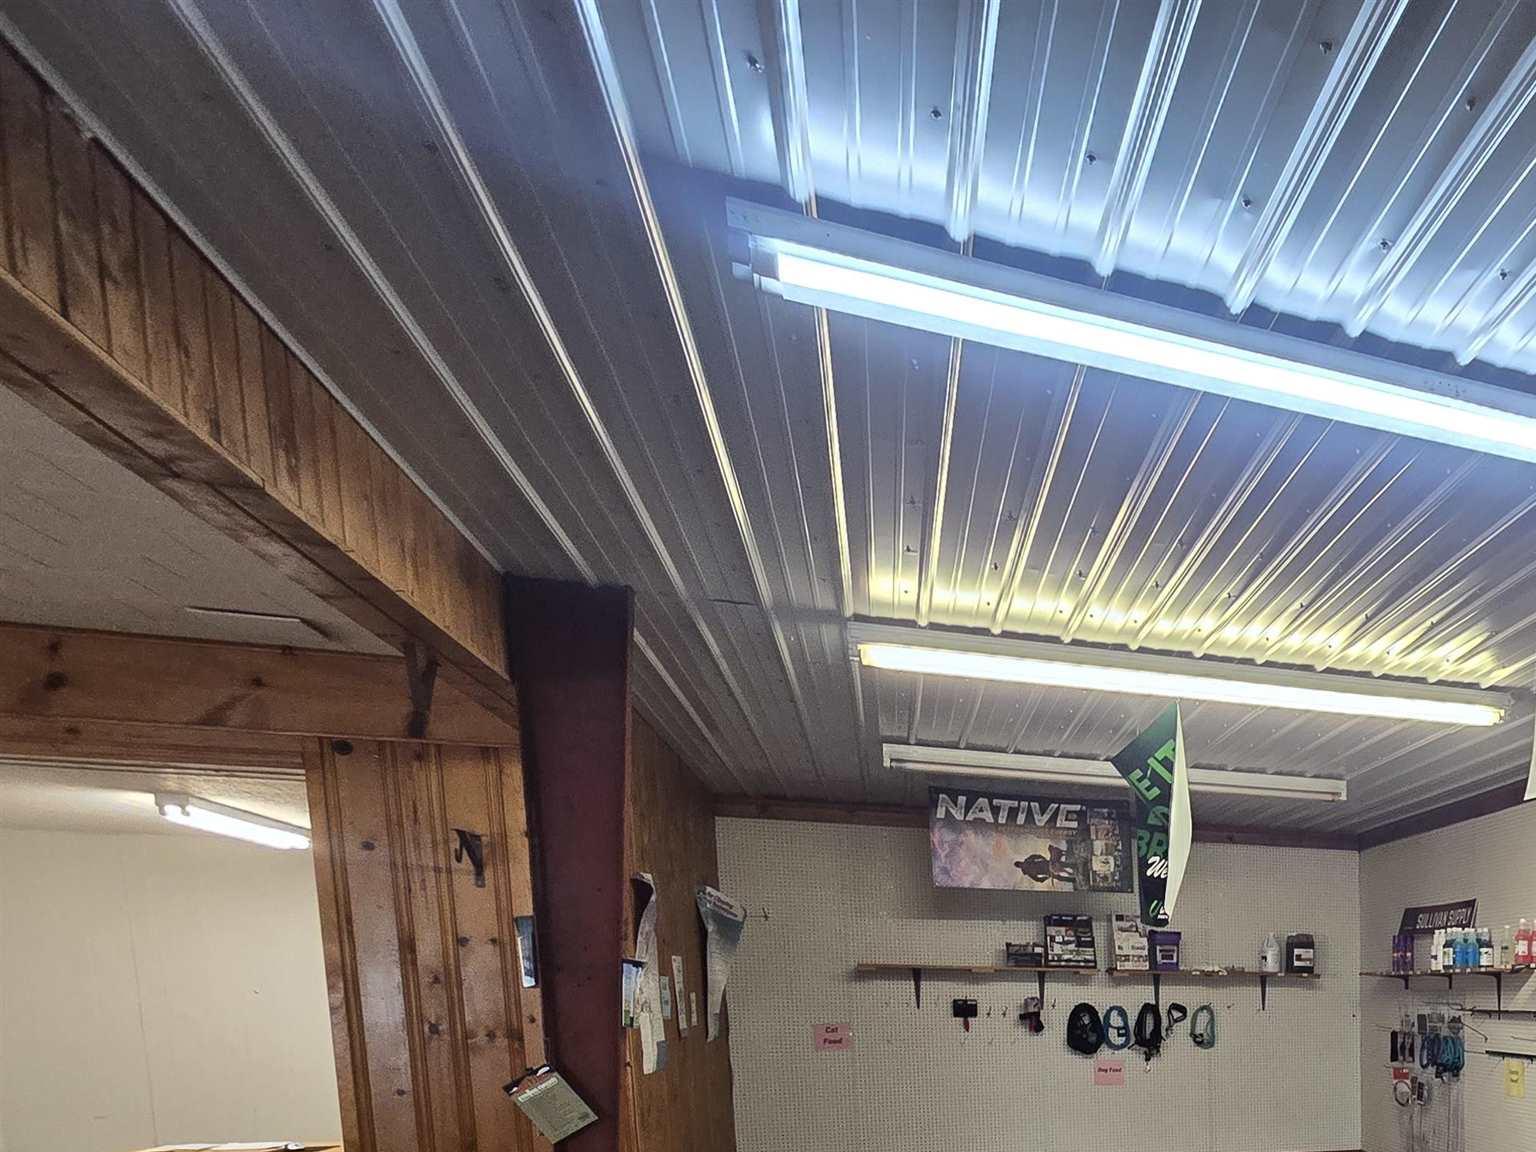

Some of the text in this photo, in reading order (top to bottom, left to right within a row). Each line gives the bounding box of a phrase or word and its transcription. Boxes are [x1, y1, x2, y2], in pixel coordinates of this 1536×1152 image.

[936, 794, 1082, 828] NATIVE
[1416, 907, 1473, 929] SULLIVAN SUPPLY
